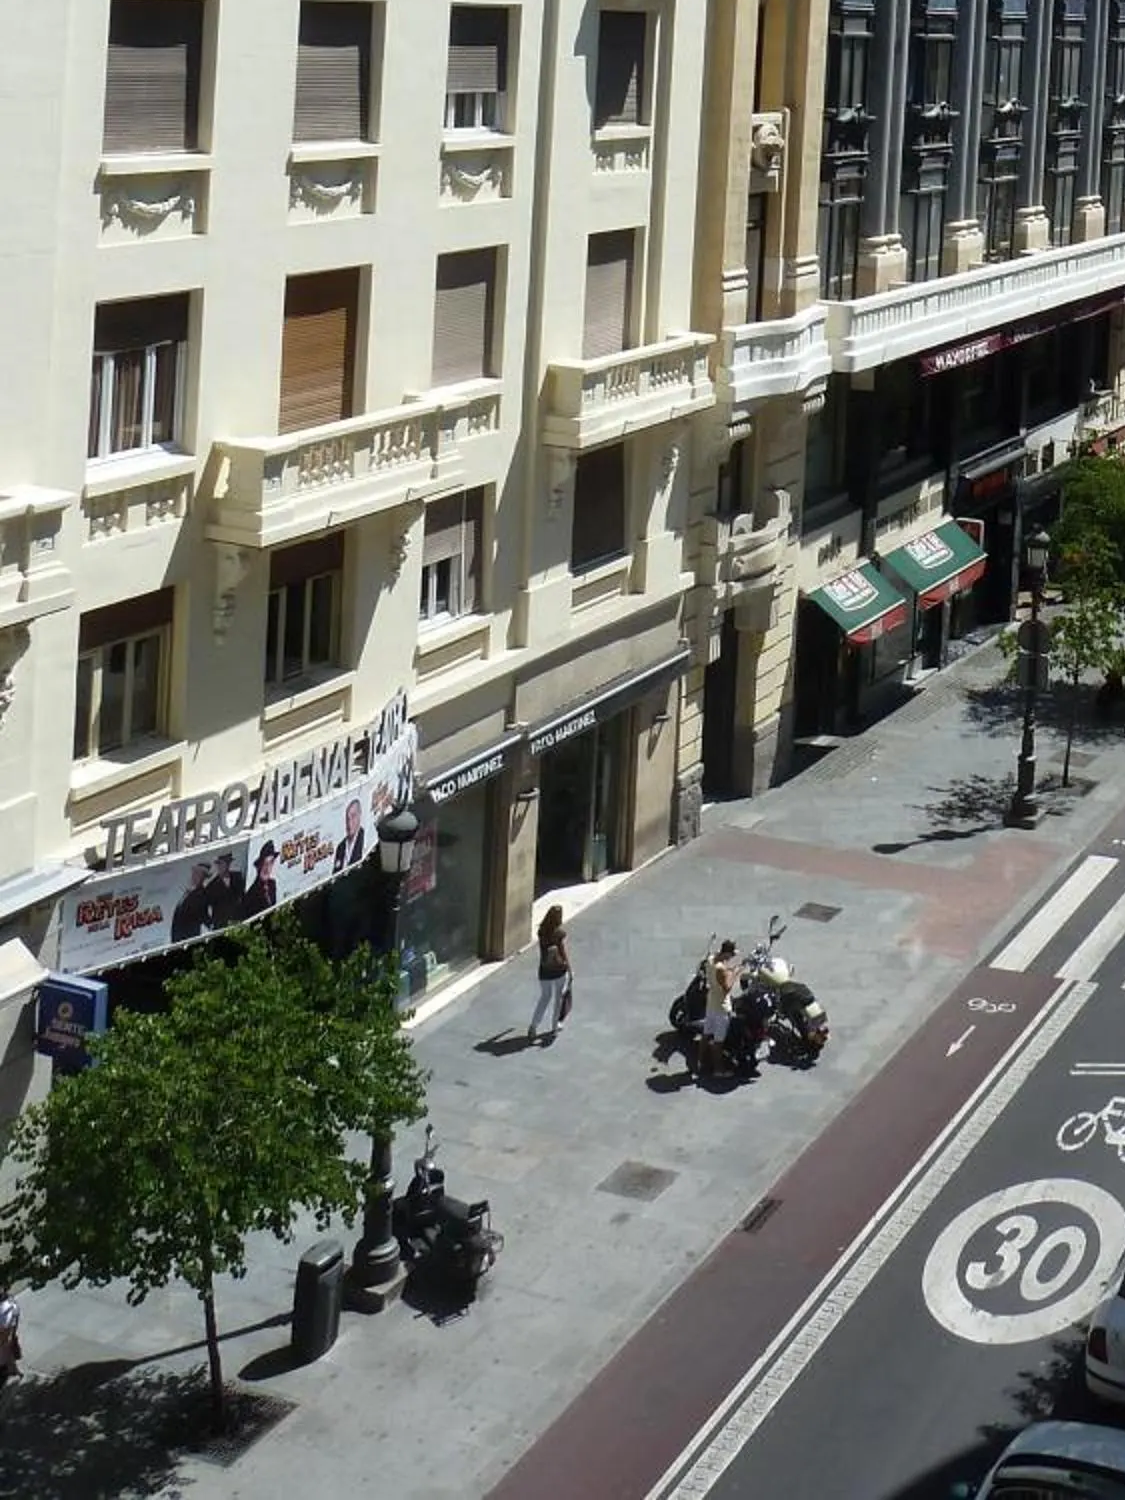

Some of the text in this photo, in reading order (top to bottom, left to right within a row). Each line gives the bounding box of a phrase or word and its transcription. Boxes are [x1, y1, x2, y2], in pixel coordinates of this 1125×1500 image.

[555, 709, 597, 743] MARTINEZ
[457, 754, 504, 788] MARTINEZ
[100, 781, 248, 871] TEATRO
[254, 732, 364, 825] ARENAL
[965, 1214, 1087, 1301] 30
